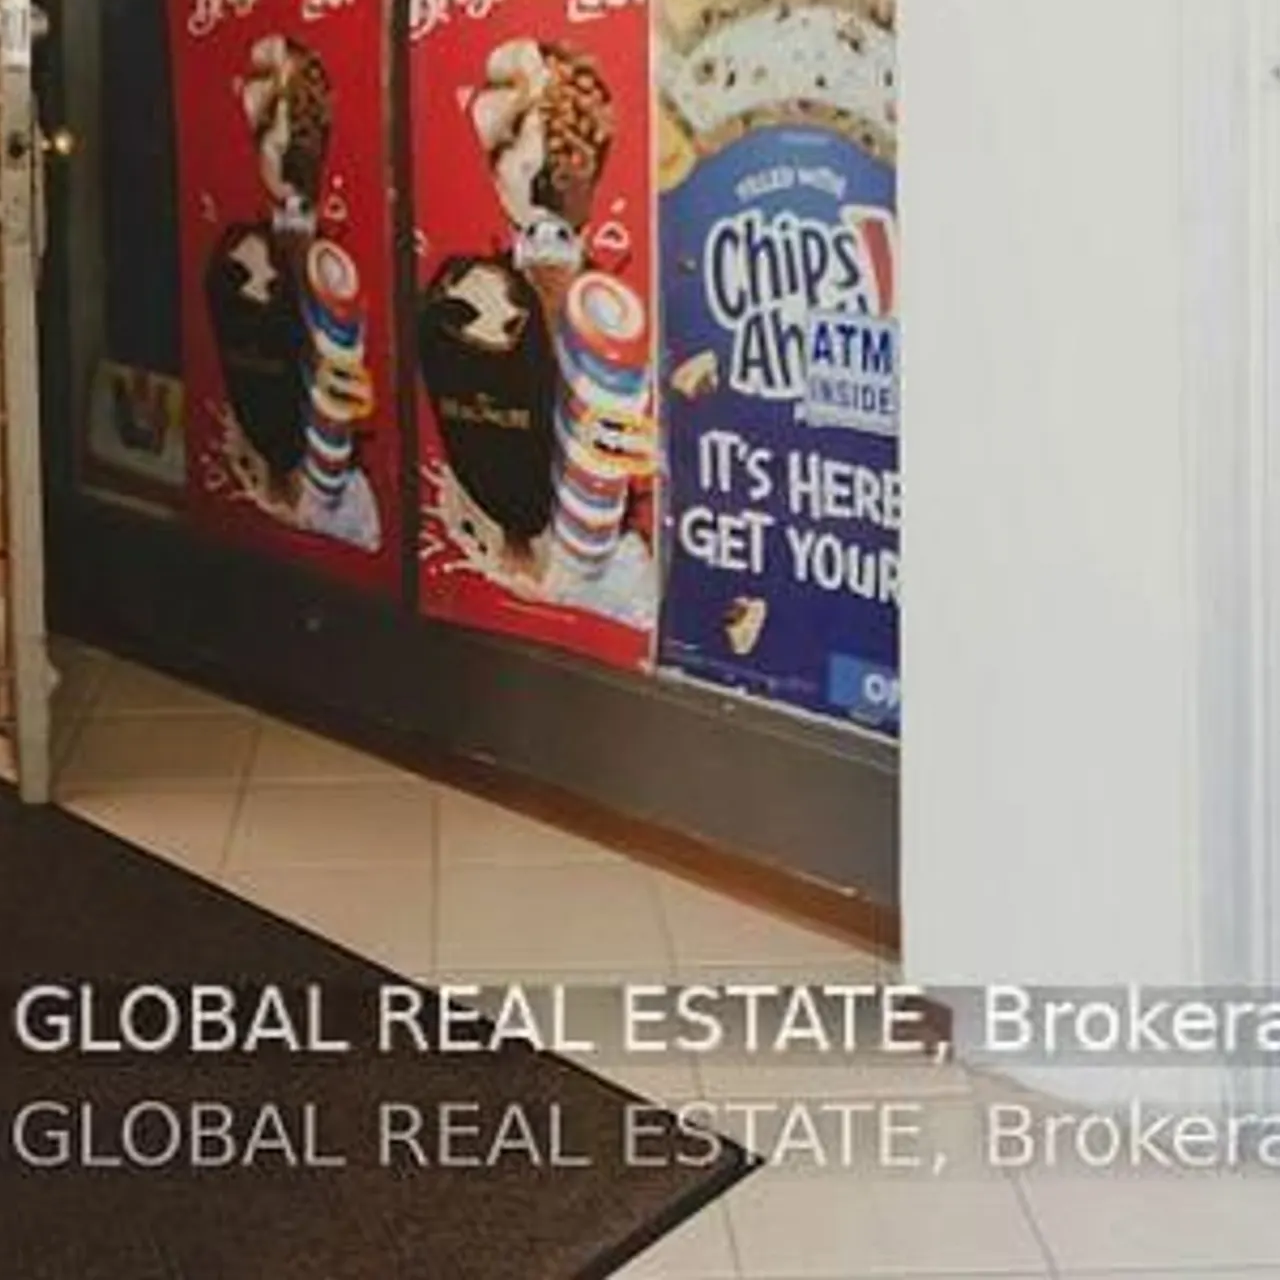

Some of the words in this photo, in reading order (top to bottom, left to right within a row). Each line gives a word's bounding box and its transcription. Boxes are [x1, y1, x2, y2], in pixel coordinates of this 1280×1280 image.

[707, 212, 863, 324] Chips
[733, 308, 806, 398] Ah
[811, 320, 894, 376] ATM
[808, 378, 896, 416] INSIDE
[698, 428, 774, 501] IT'S
[680, 506, 775, 575] GET
